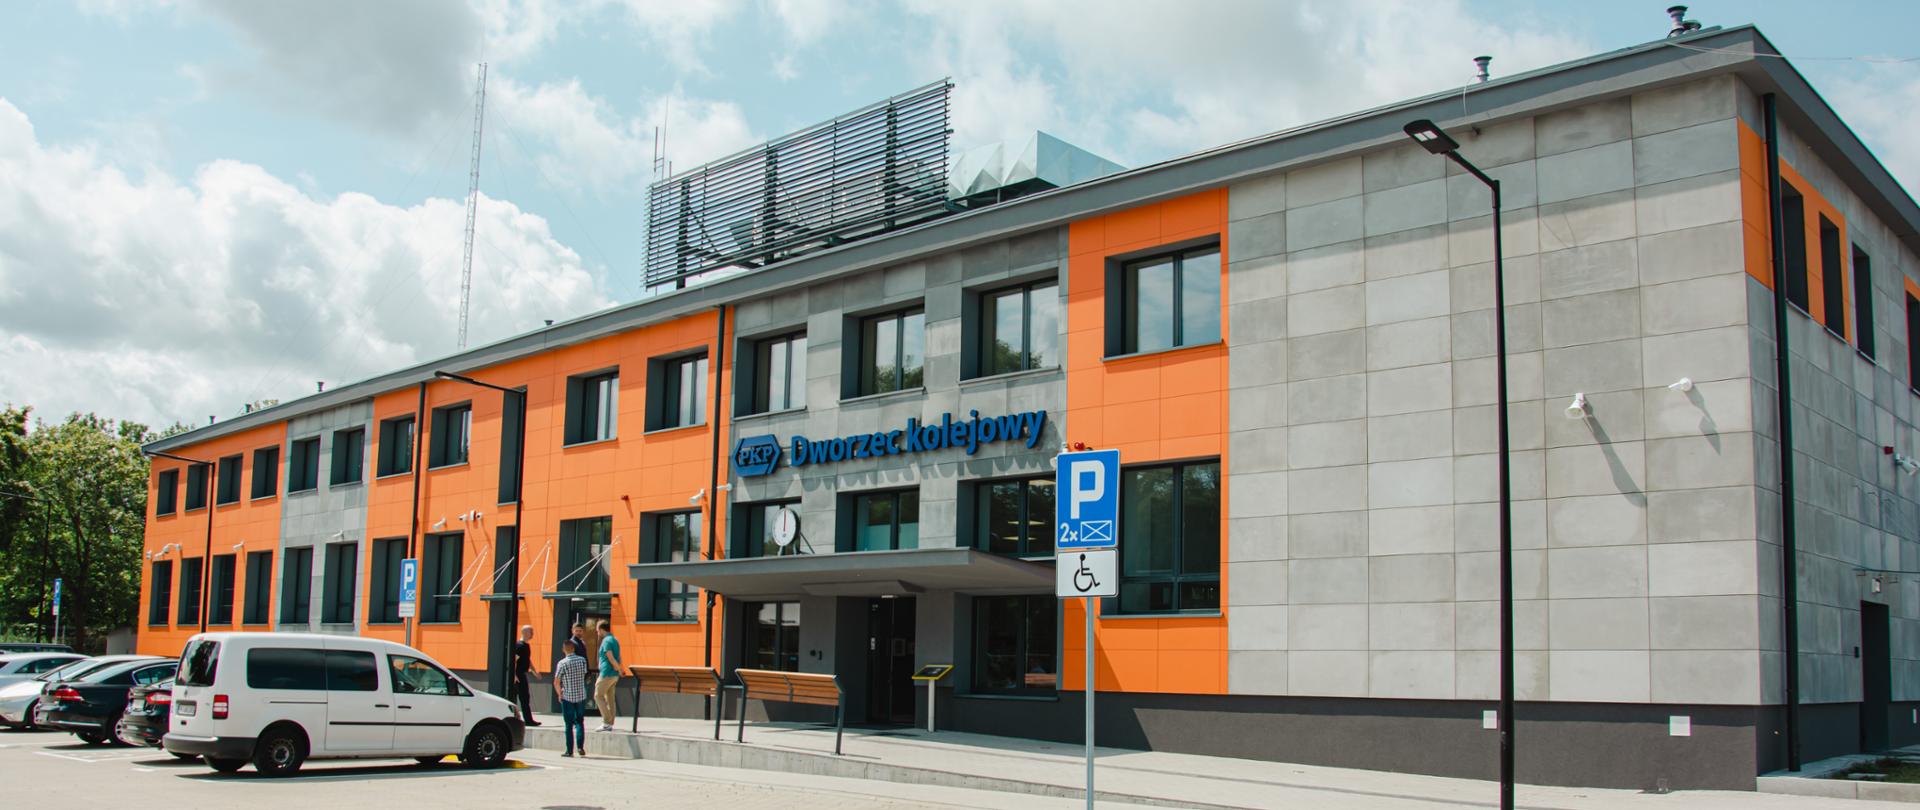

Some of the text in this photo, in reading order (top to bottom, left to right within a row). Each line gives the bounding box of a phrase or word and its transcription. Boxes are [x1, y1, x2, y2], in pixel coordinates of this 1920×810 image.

[738, 409, 1047, 467] PKP Dworzec kolejowy
[1070, 460, 1105, 519] P
[403, 563, 415, 590] P
